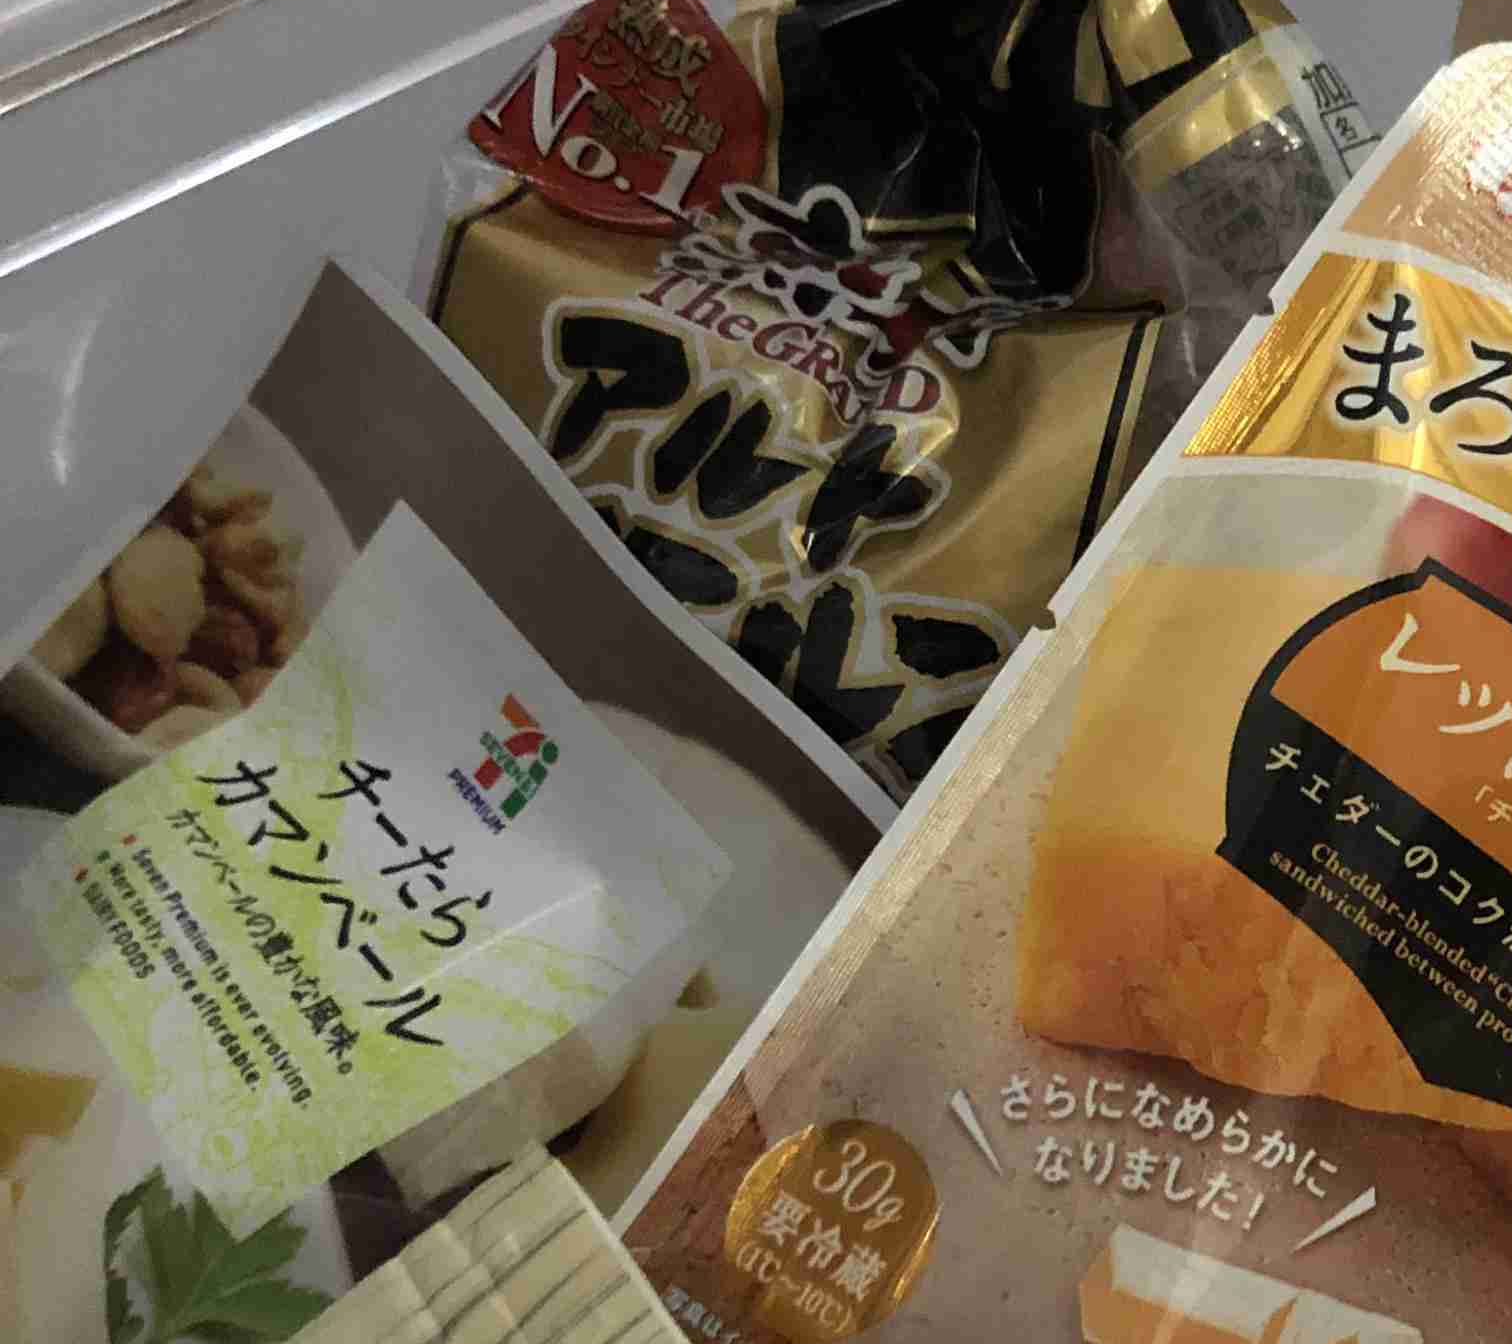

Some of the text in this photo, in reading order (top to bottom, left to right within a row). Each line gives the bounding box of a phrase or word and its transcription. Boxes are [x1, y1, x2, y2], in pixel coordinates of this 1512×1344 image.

[197, 758, 446, 1049] カマンベール
[318, 758, 494, 949] チーたら
[161, 889, 222, 969] Premium
[249, 1019, 320, 1113] evolving.
[1268, 846, 1394, 953] sandwiched
[1394, 936, 1480, 1018] between
[189, 986, 269, 1095] affordable.
[811, 1138, 906, 1230] 30g
[1000, 1072, 1342, 1199] さらになめらかに
[752, 1196, 890, 1302] 要冷蔵
